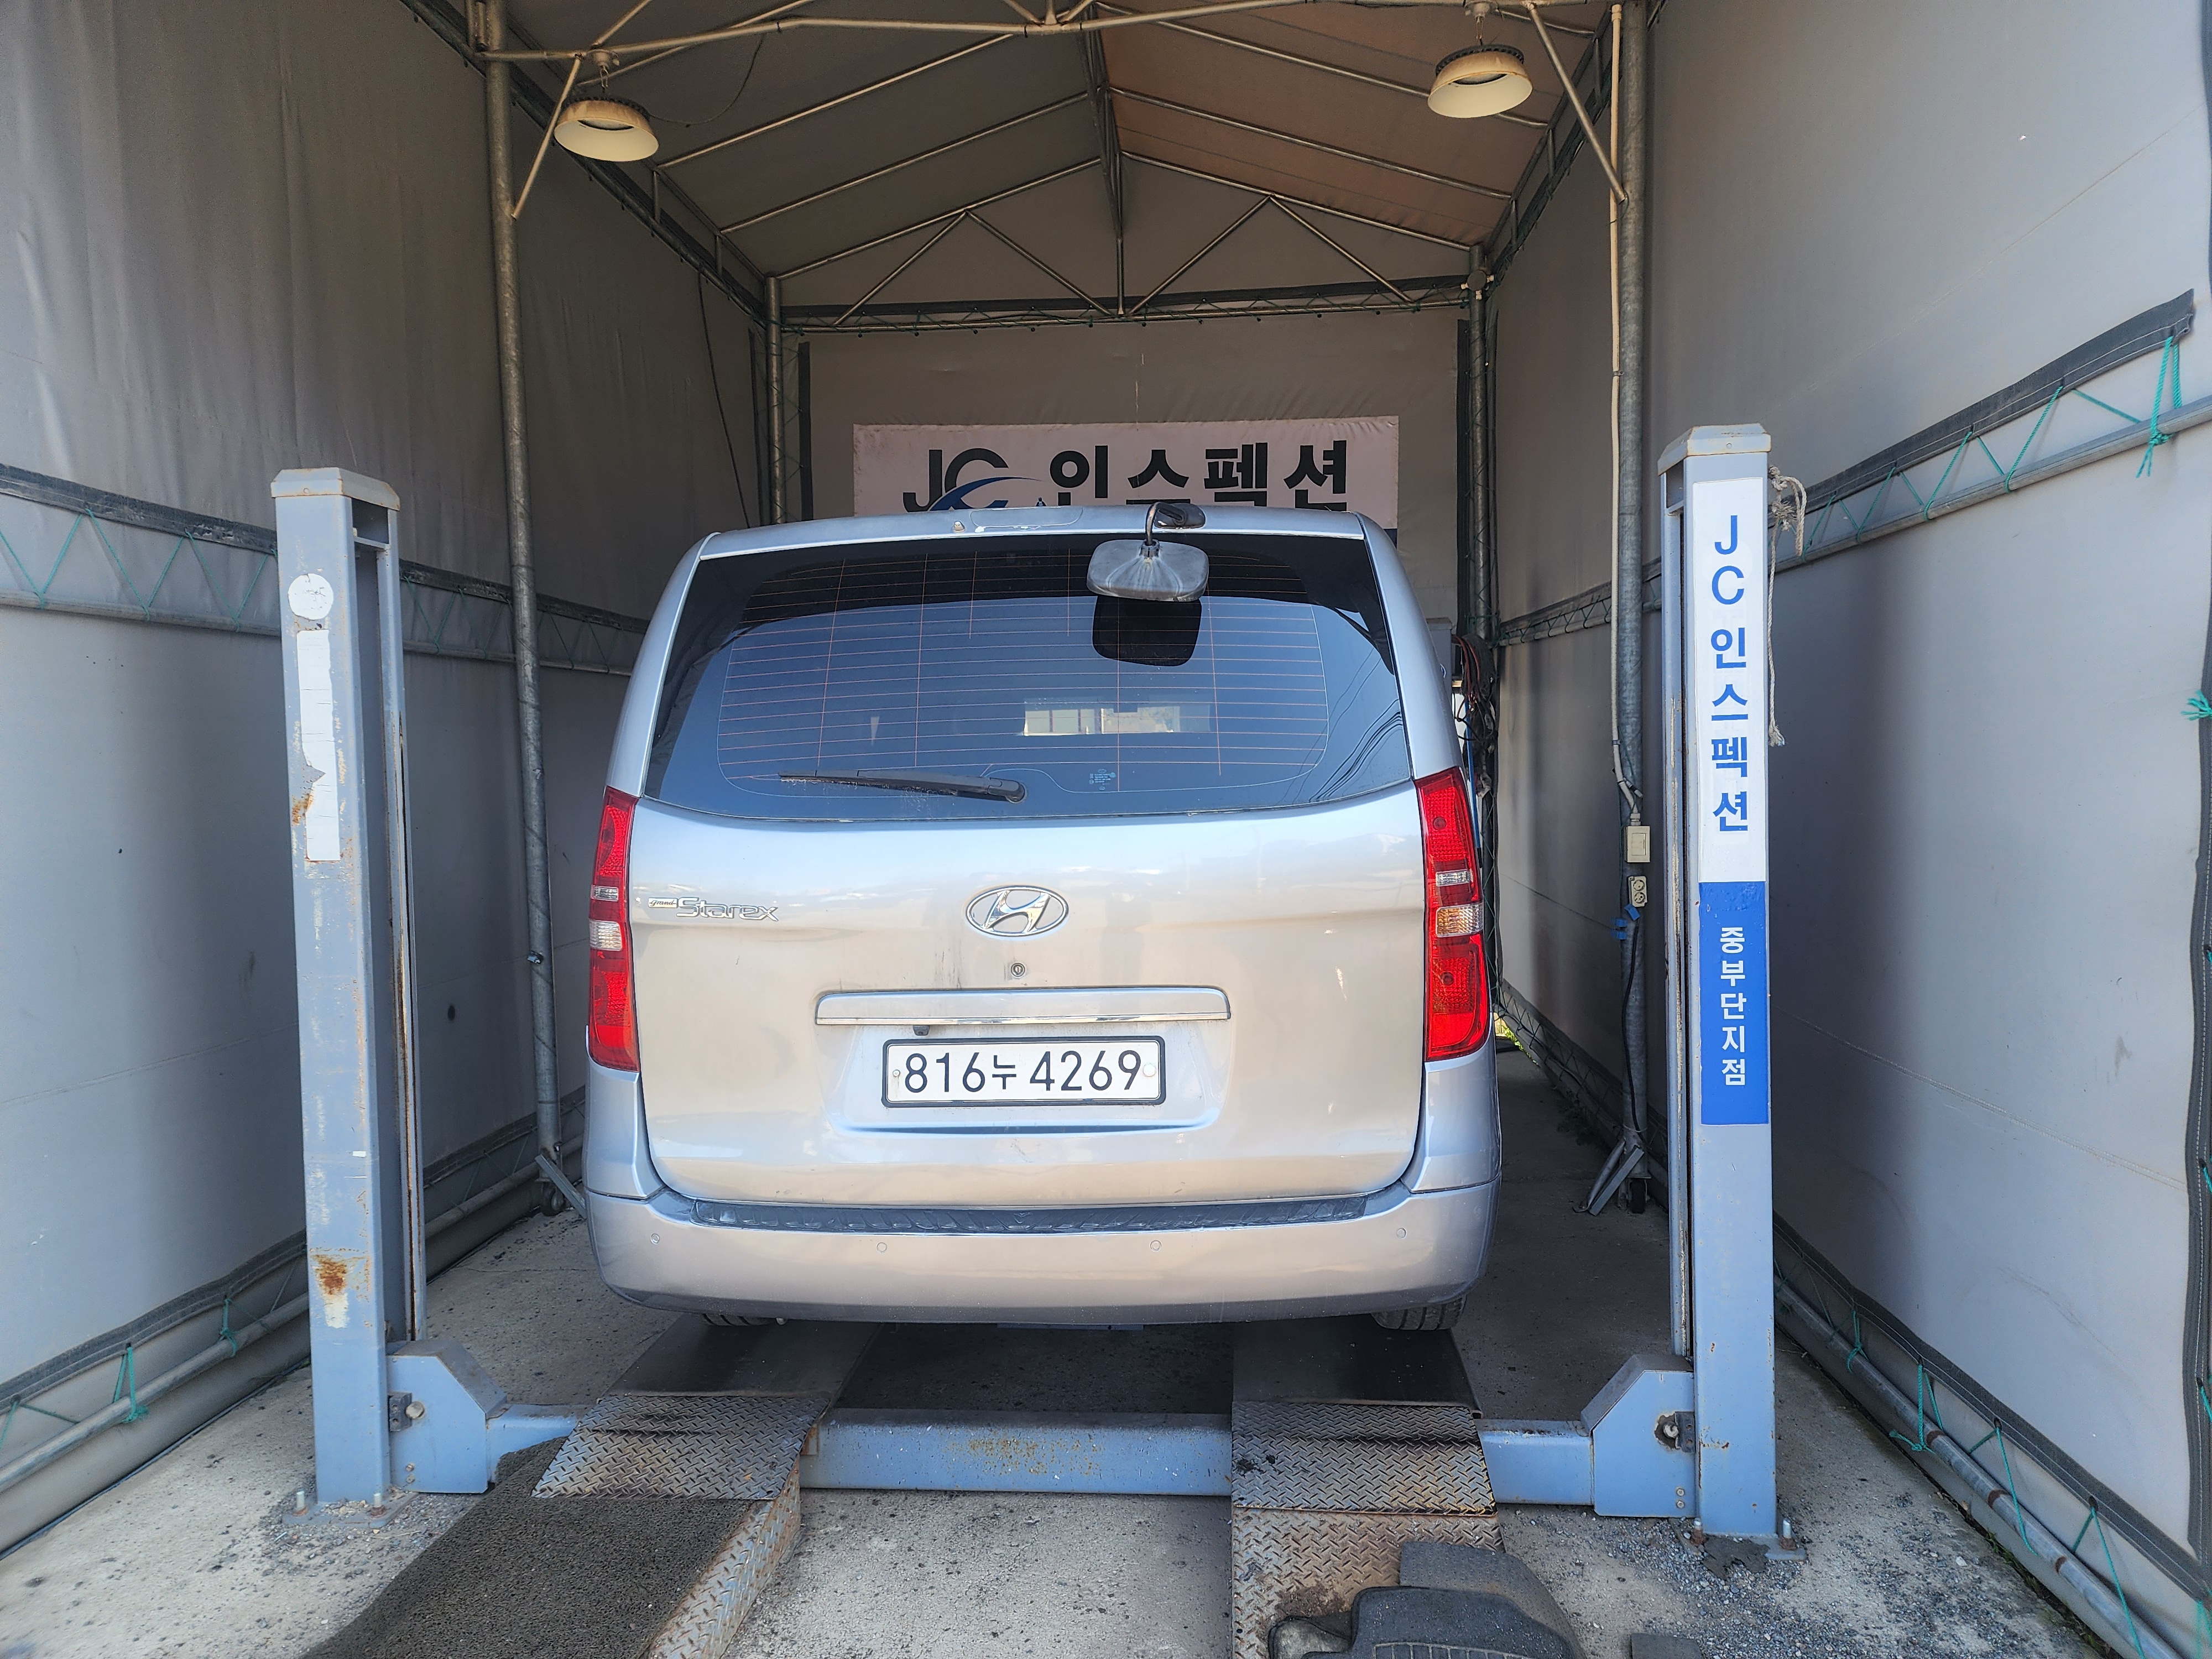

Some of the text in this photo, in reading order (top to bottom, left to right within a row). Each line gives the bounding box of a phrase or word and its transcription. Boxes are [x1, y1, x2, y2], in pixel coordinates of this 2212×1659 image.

[902, 440, 1348, 513] JC 인스펙션
[676, 896, 779, 922] Starex
[1719, 927, 1747, 1086] 중부단지점
[904, 1049, 1143, 1093] 816누 4269
